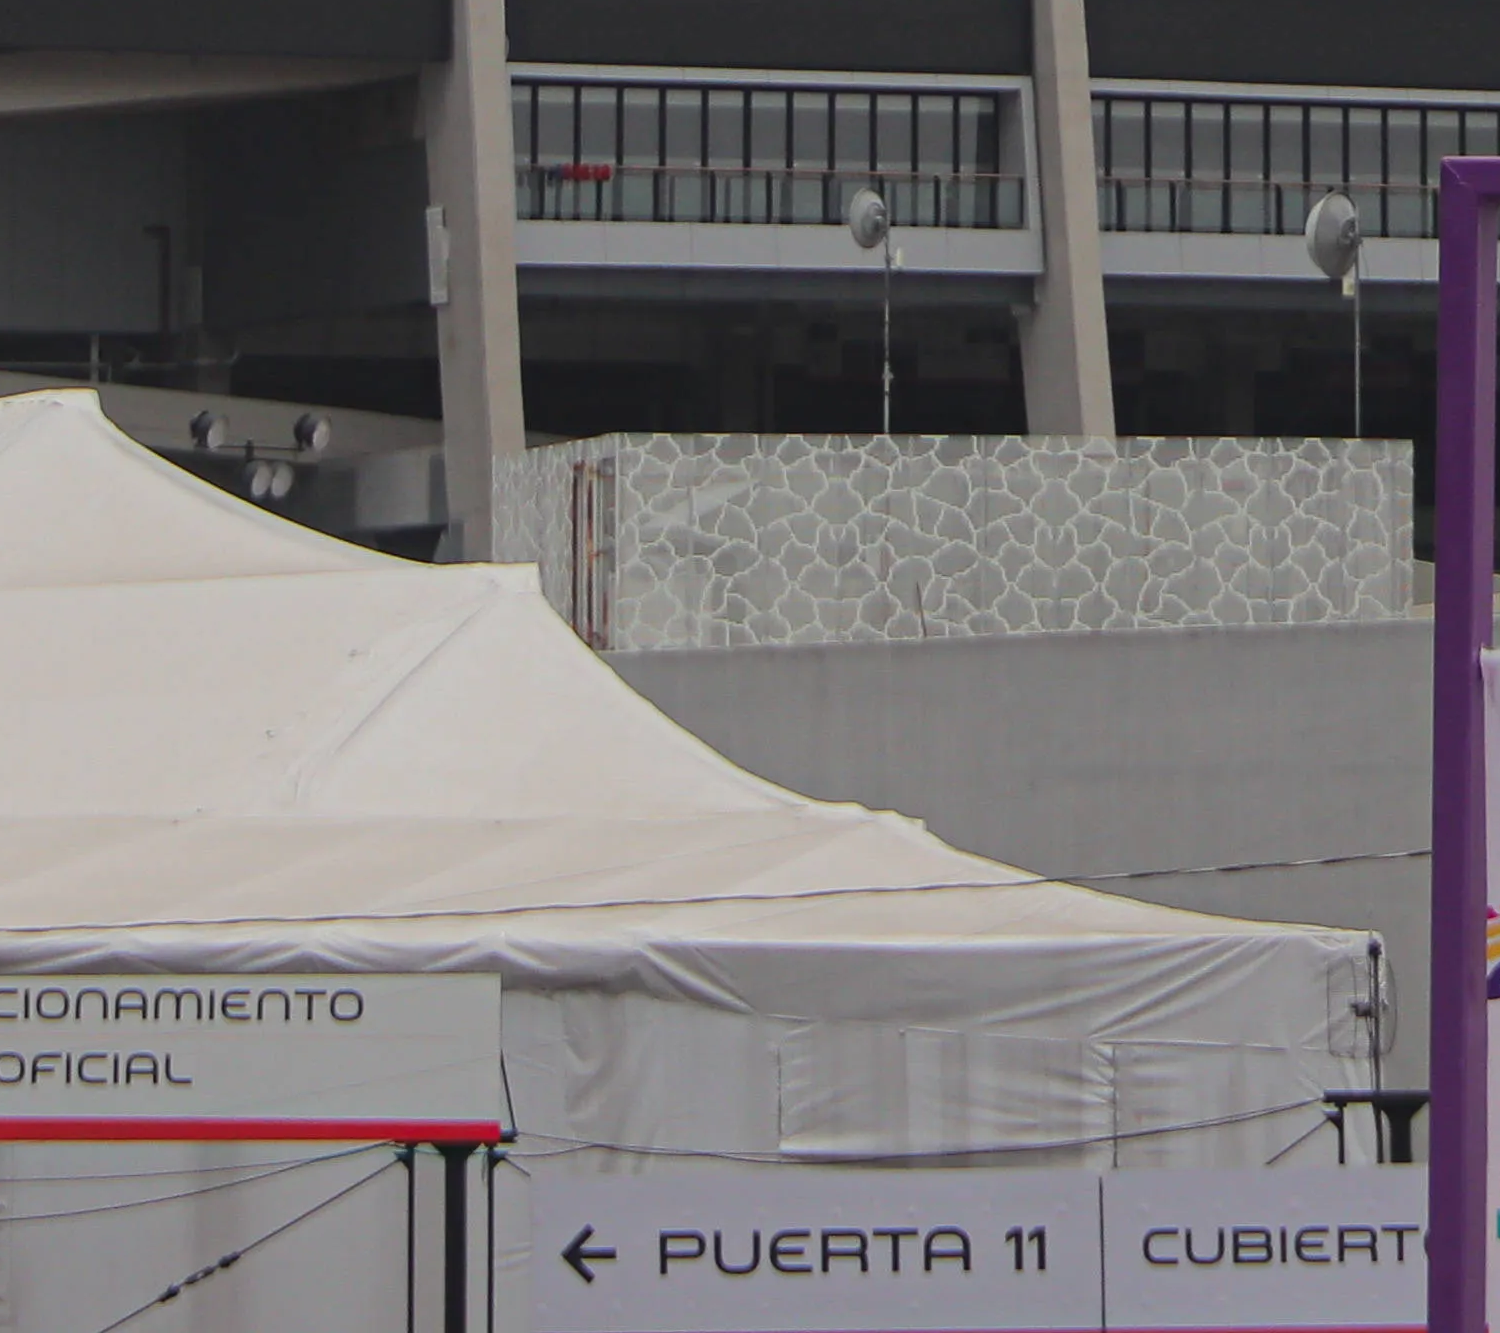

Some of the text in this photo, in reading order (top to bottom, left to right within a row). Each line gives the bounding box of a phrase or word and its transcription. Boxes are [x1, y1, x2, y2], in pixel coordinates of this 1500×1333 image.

[657, 1225, 1048, 1275] PUERTA 11
[1141, 1222, 1430, 1265] CUBIERT
